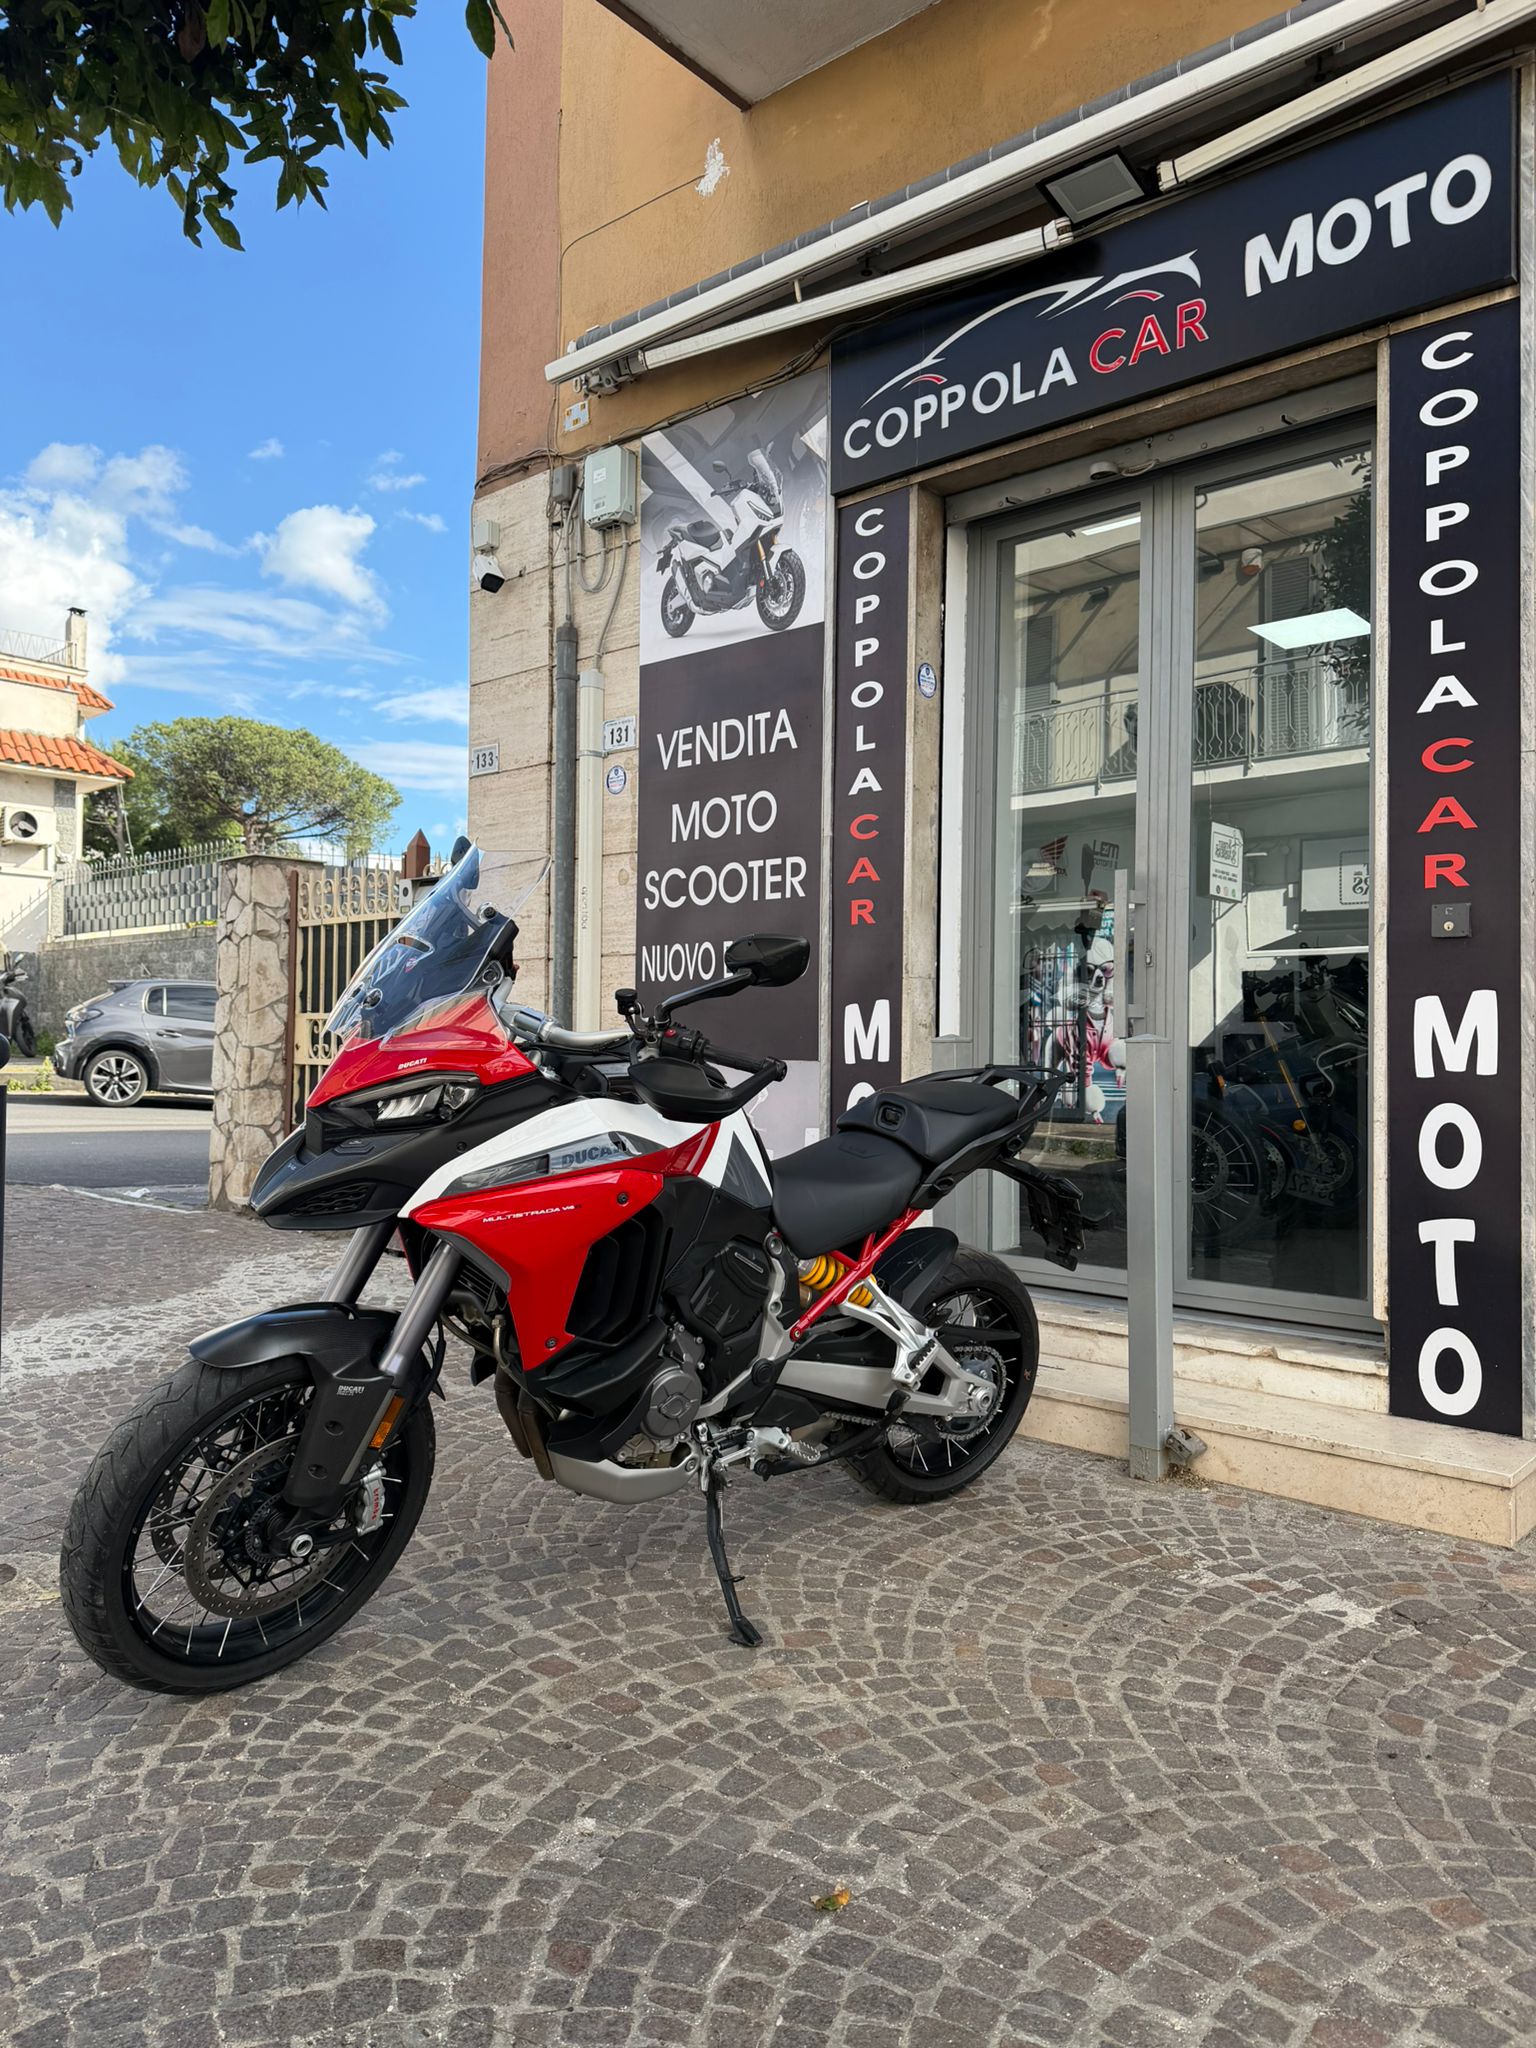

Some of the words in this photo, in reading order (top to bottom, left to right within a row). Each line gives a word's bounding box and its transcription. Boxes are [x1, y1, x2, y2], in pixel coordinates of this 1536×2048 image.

[843, 346, 1078, 459] COPPOLA
[1089, 298, 1209, 374] CAR
[1244, 154, 1492, 297] MOTO
[1417, 331, 1479, 714] COPPOLA
[849, 508, 886, 796] COPPOLA
[476, 751, 494, 770] 133
[610, 725, 629, 745] 131
[656, 708, 798, 771] VENDITA
[671, 791, 778, 843] MOTO
[1417, 737, 1478, 889] CAR
[644, 856, 807, 910] SCOOTER
[847, 814, 880, 927] CAR
[641, 941, 716, 982] NUOVO
[397, 1057, 428, 1070] DUCATI
[482, 1207, 561, 1223] MULTISTRADA
[1413, 989, 1499, 1416] MOTO
[337, 1385, 365, 1394] DUCATI
